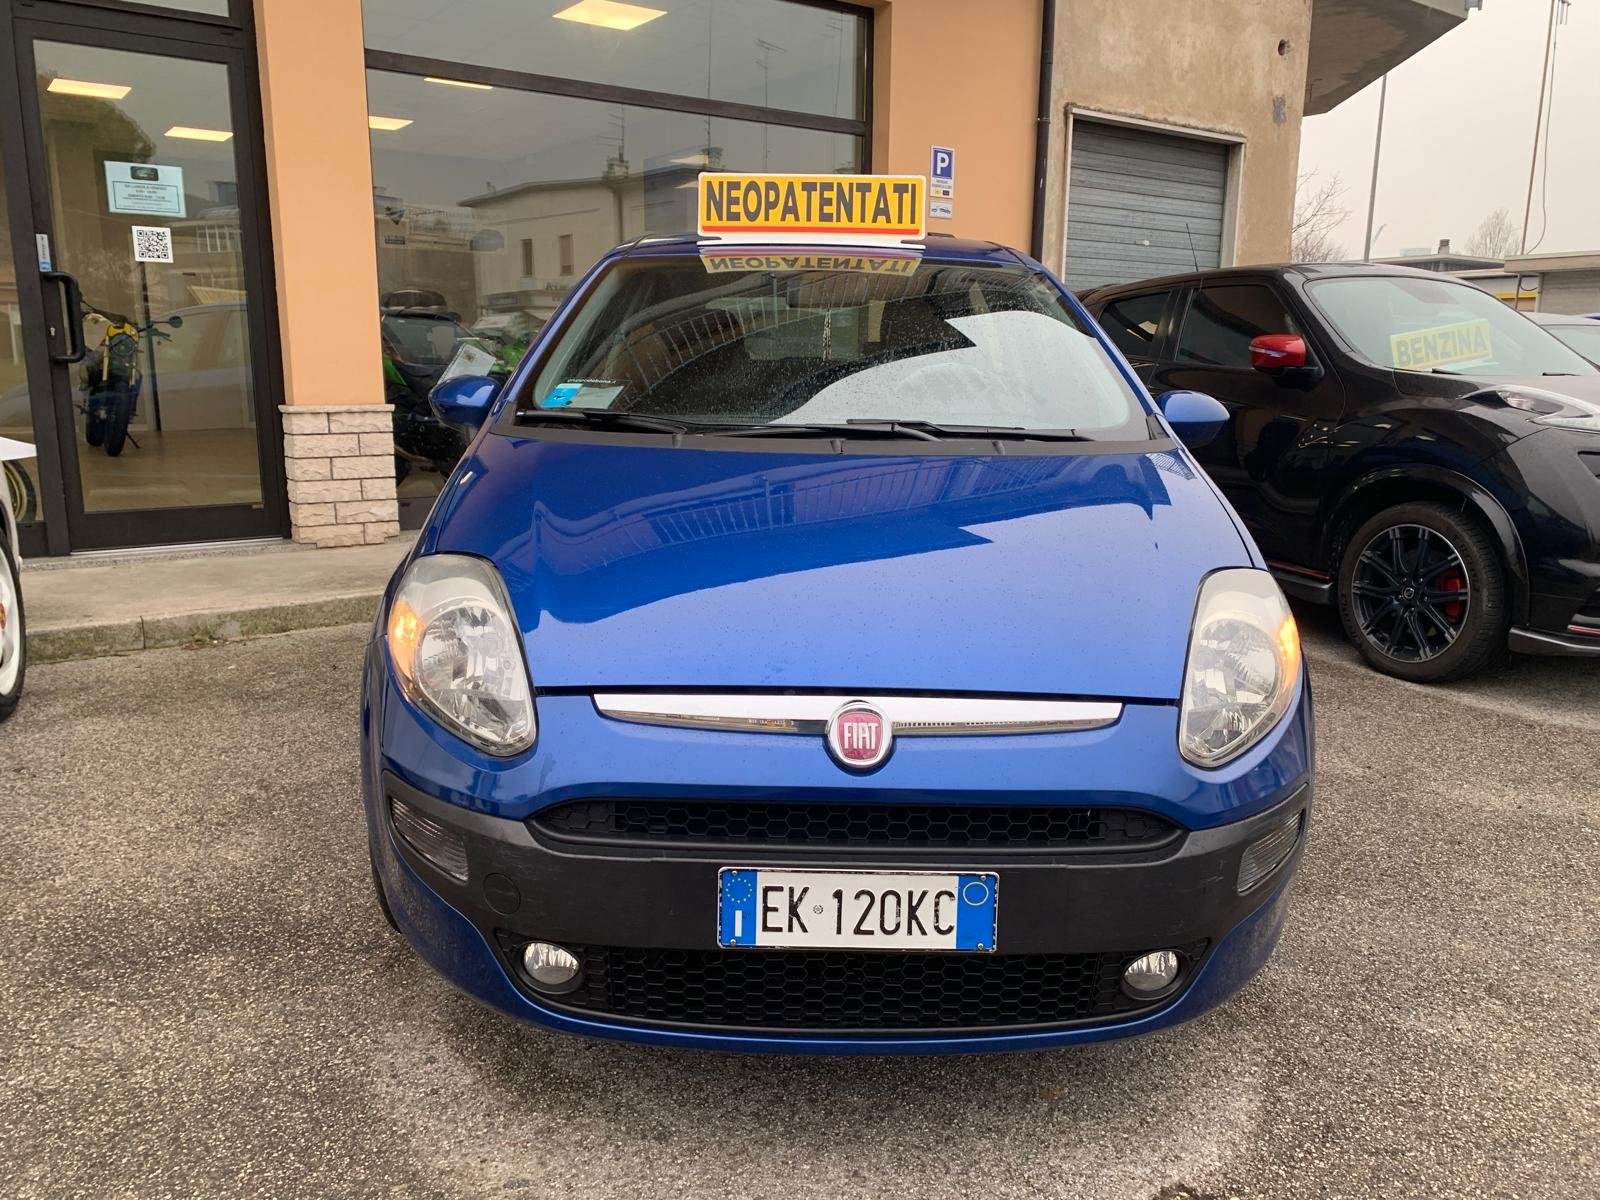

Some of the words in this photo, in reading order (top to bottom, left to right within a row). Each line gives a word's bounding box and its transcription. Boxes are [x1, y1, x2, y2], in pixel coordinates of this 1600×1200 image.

[936, 152, 949, 175] P
[706, 180, 917, 224] NEOPATENTATI
[1396, 326, 1488, 366] BENZINA
[843, 722, 879, 750] FIAT
[761, 885, 810, 933] EK
[831, 888, 956, 936] 120KC
